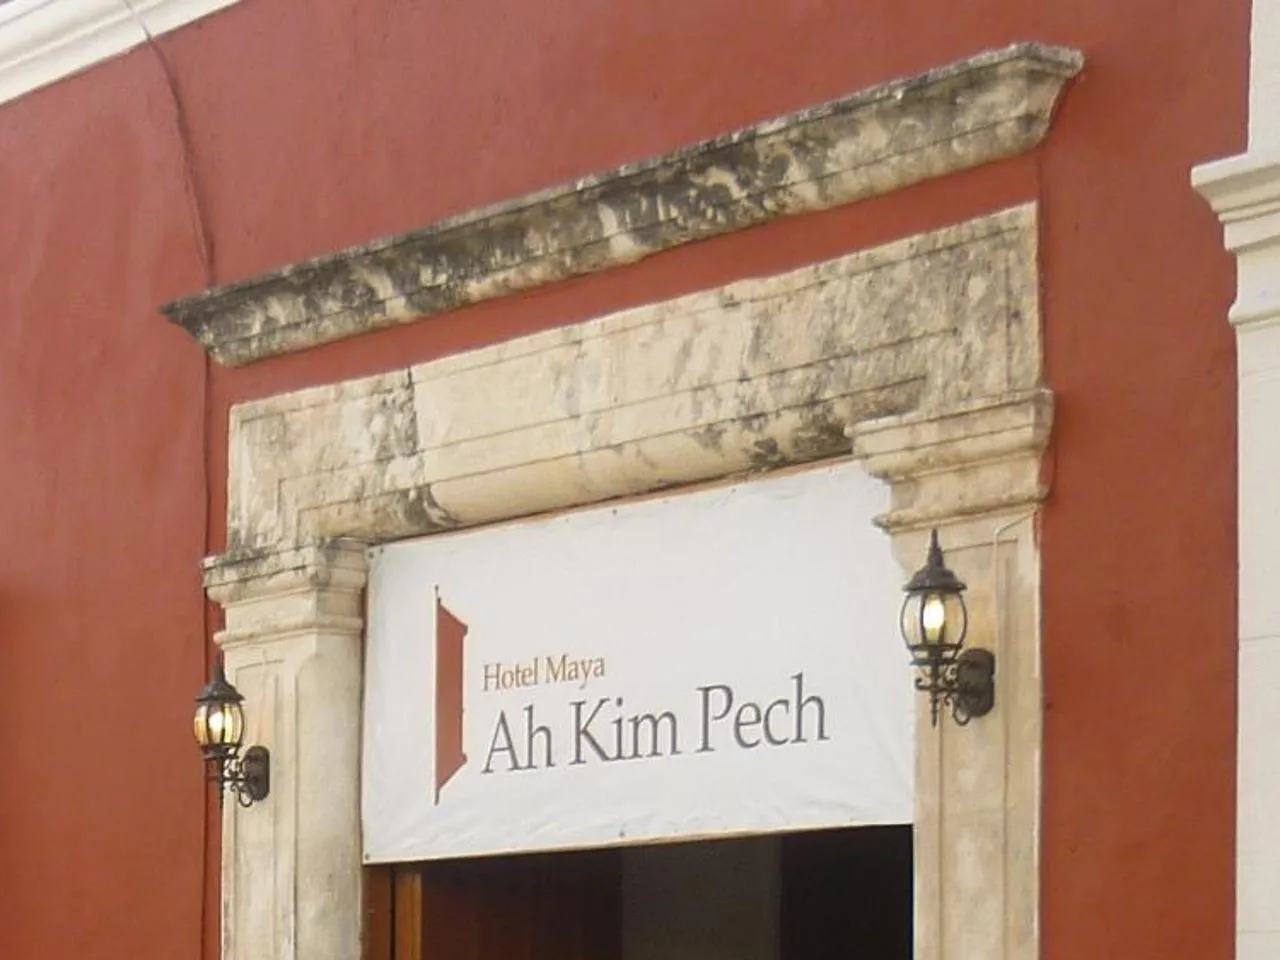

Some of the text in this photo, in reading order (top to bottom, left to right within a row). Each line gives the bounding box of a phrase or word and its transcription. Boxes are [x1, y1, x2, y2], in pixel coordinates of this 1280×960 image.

[483, 653, 606, 692] Hotel Maya
[480, 672, 831, 775] Ah Kim Pech
